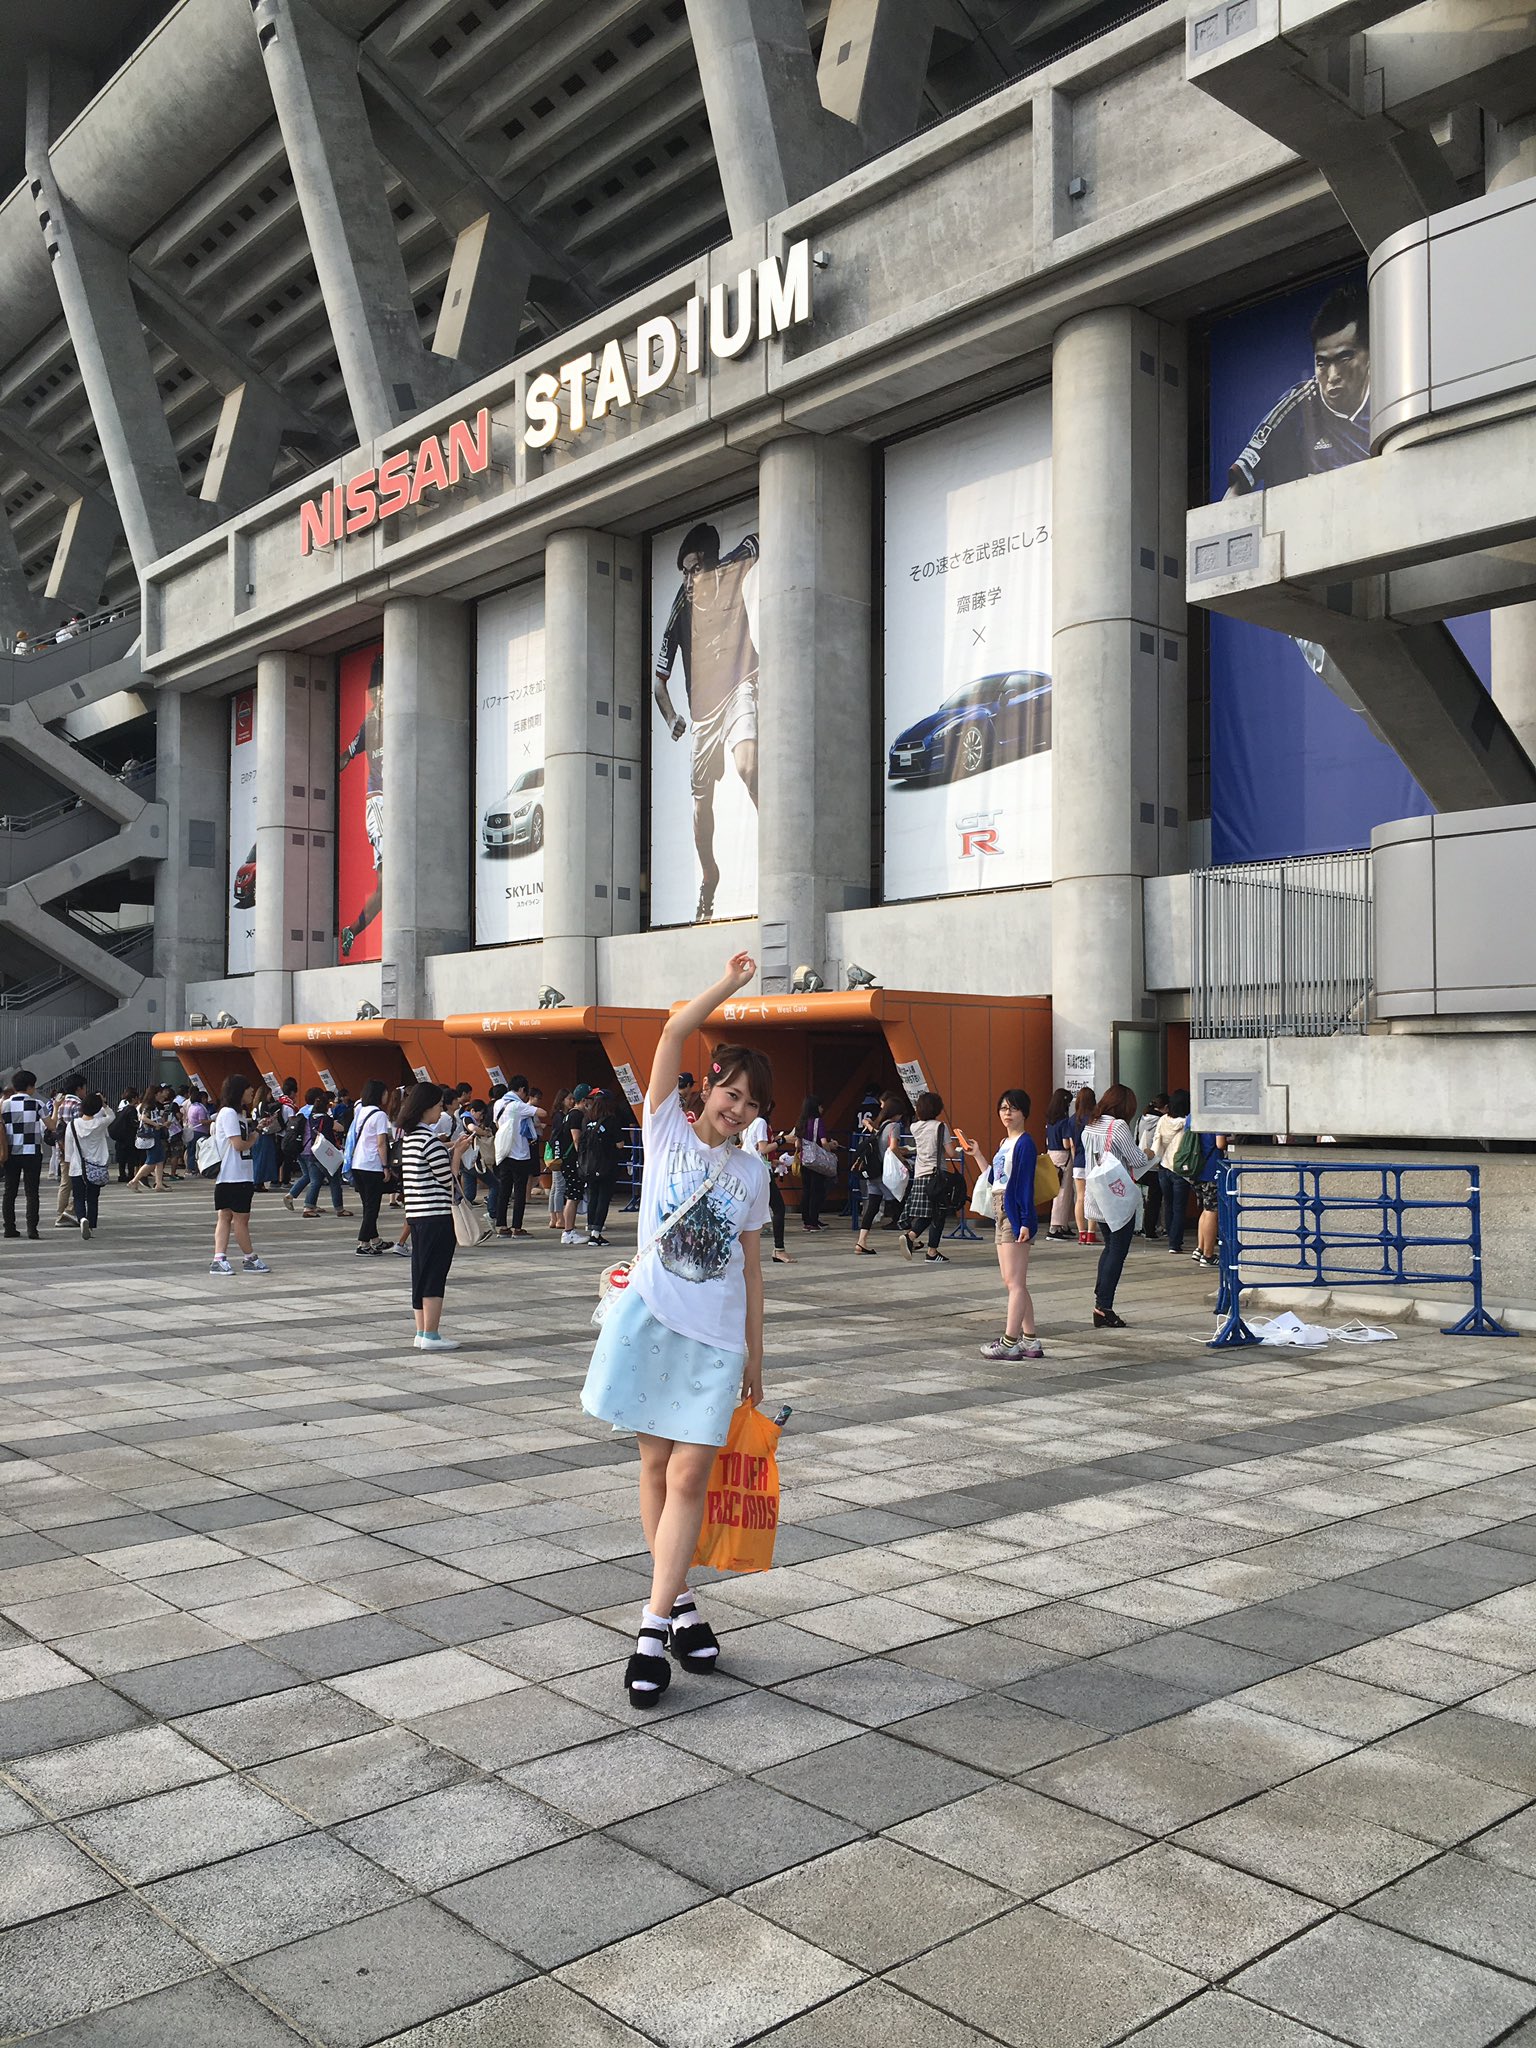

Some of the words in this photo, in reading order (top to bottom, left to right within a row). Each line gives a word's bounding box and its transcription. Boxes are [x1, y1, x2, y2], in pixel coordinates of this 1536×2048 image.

[299, 407, 493, 557] NISSAN
[523, 238, 814, 449] STADIUM
[482, 679, 546, 711] パフォーマンスを加
[958, 827, 1005, 860] R
[505, 881, 544, 899] SKYLIN
[723, 1002, 769, 1020] 西ゲート
[482, 1016, 514, 1032] 西ゲート
